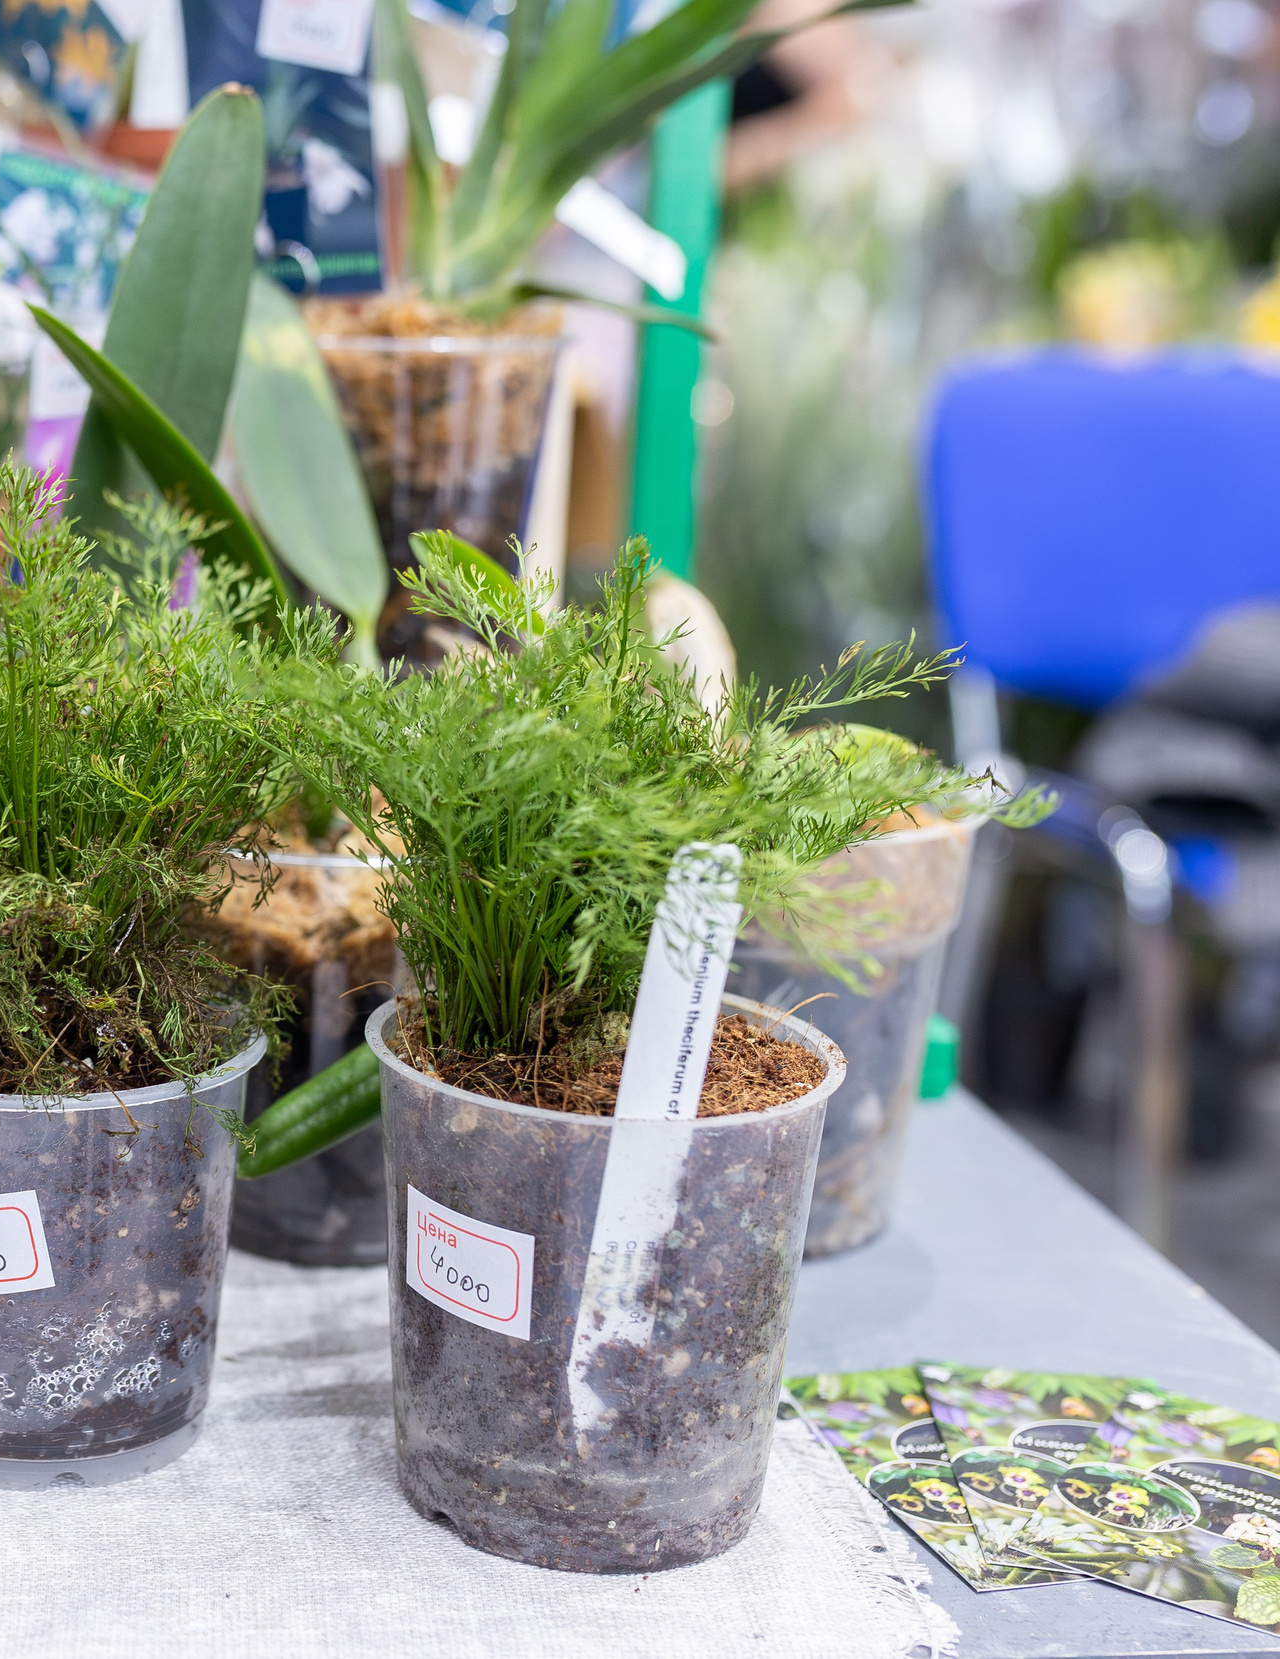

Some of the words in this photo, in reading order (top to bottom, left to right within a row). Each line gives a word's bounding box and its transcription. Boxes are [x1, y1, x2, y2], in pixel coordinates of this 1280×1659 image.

[669, 1010, 700, 1095] theciferum
[417, 1210, 458, 1249] Цена
[430, 1245, 490, 1303] 4000
